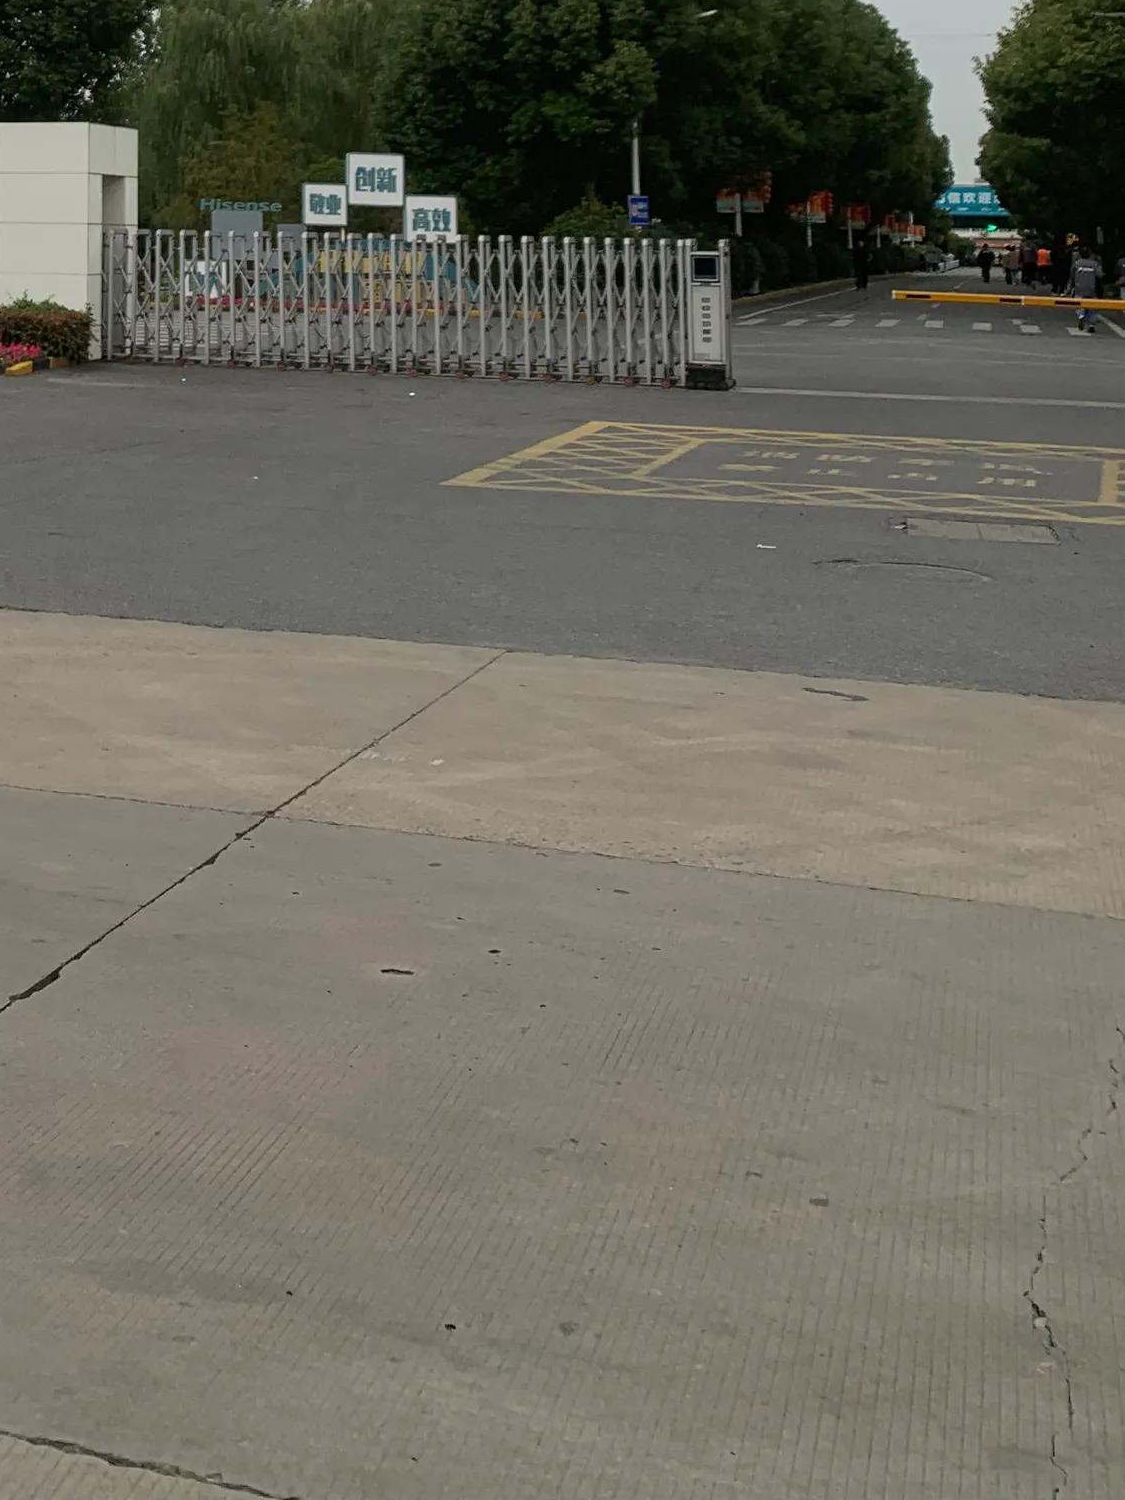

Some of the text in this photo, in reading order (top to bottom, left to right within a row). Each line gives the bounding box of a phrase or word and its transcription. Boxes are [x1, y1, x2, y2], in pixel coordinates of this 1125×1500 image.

[355, 166, 396, 193] 创新
[199, 198, 283, 213] Hisense
[412, 207, 451, 233] 高效
